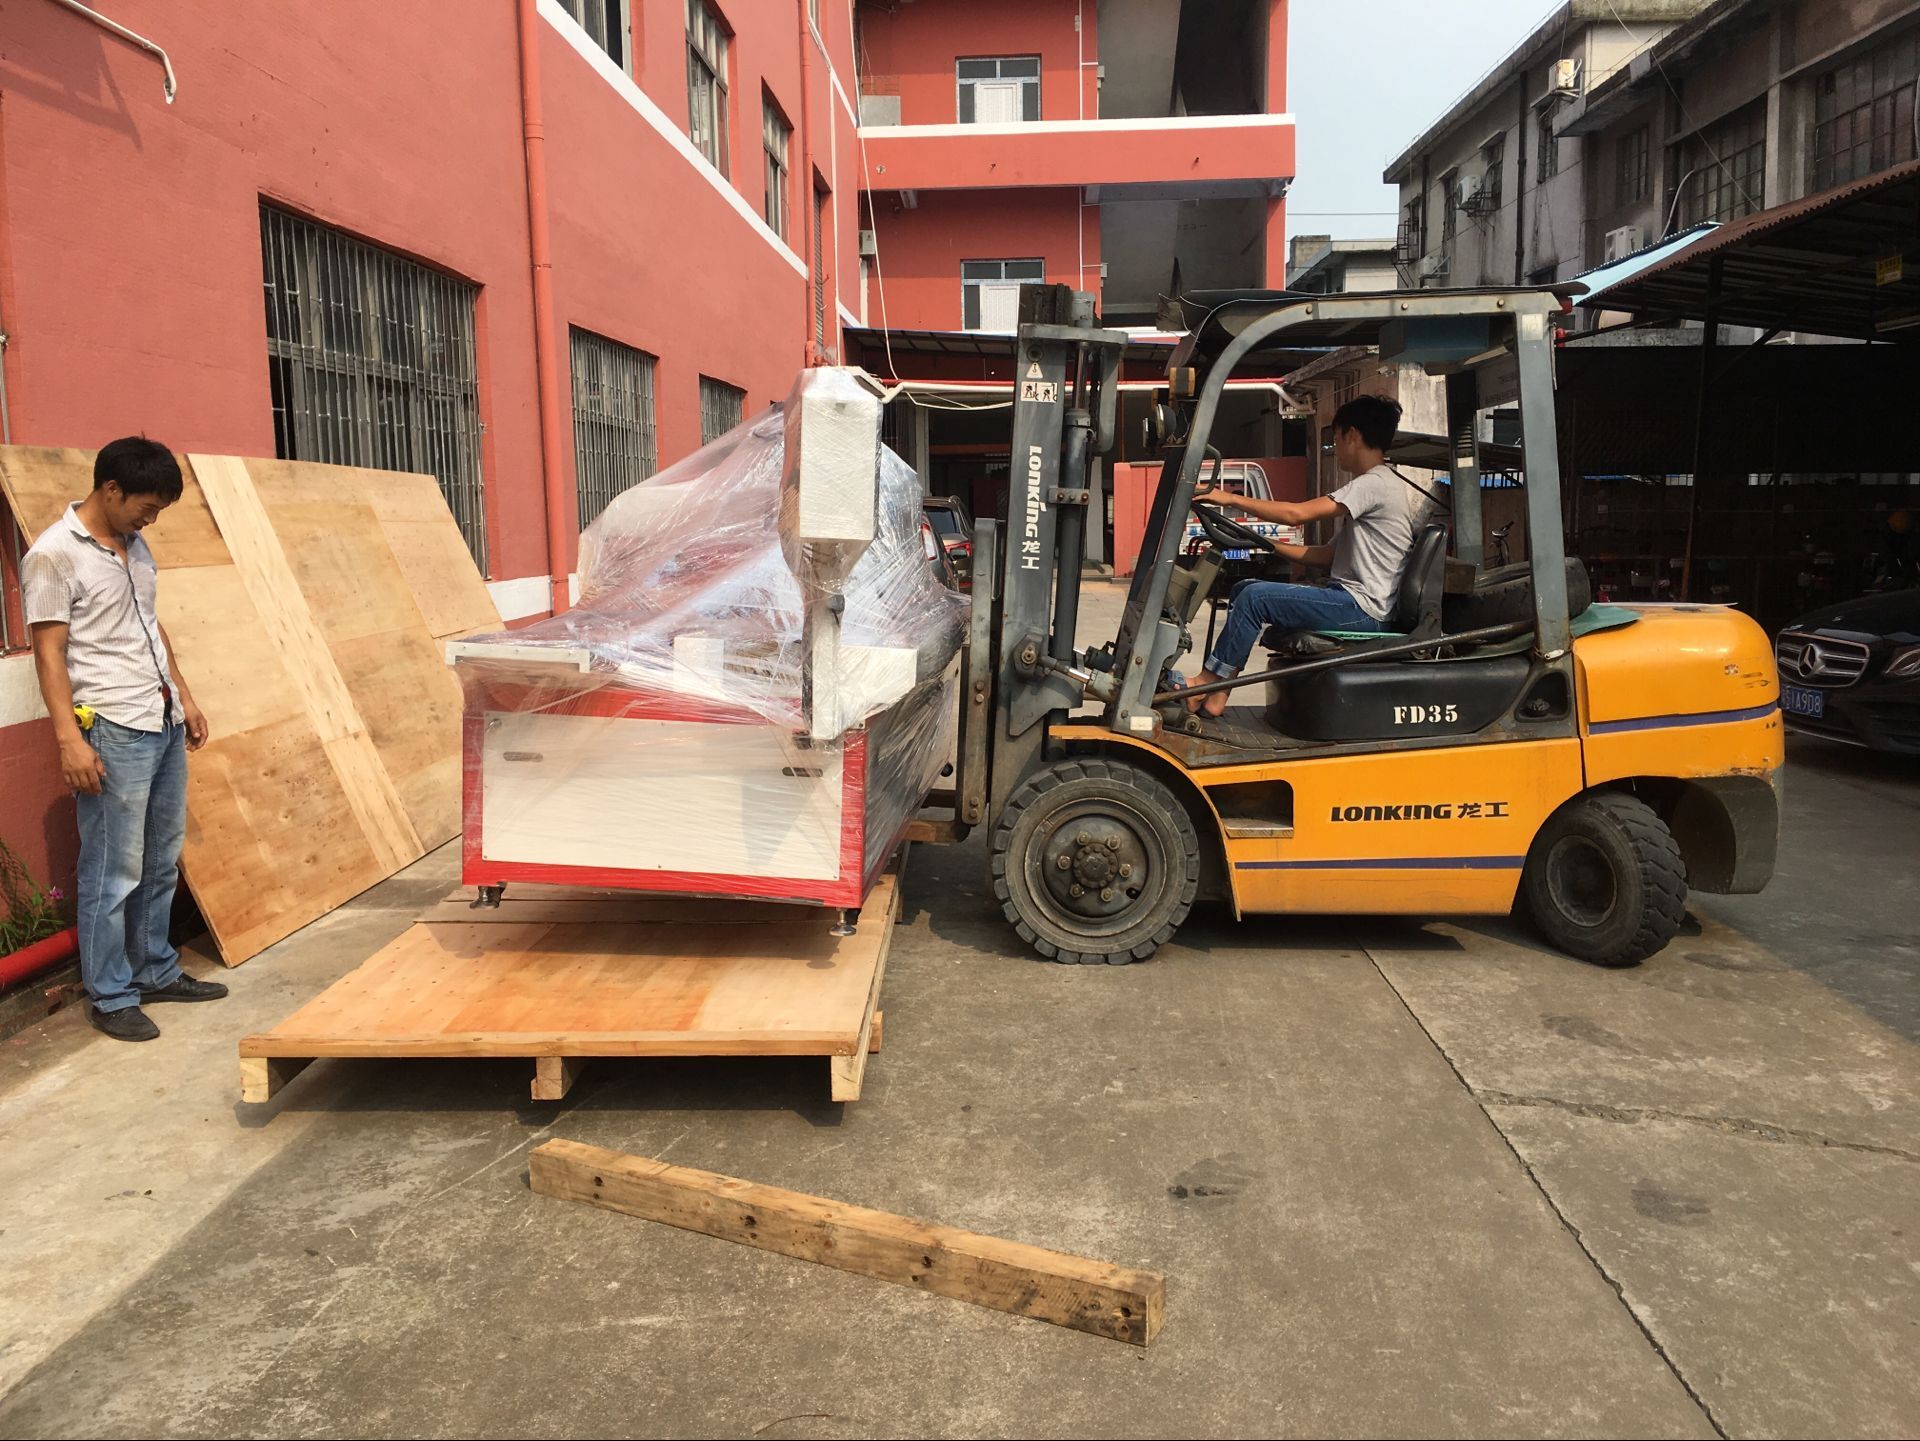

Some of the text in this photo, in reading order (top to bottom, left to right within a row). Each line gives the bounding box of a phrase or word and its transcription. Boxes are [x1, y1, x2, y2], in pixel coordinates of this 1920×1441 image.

[1021, 445, 1047, 570] LONKING 龙工
[1393, 704, 1458, 724] FD35
[1331, 802, 1509, 822] LONKING 龙工
